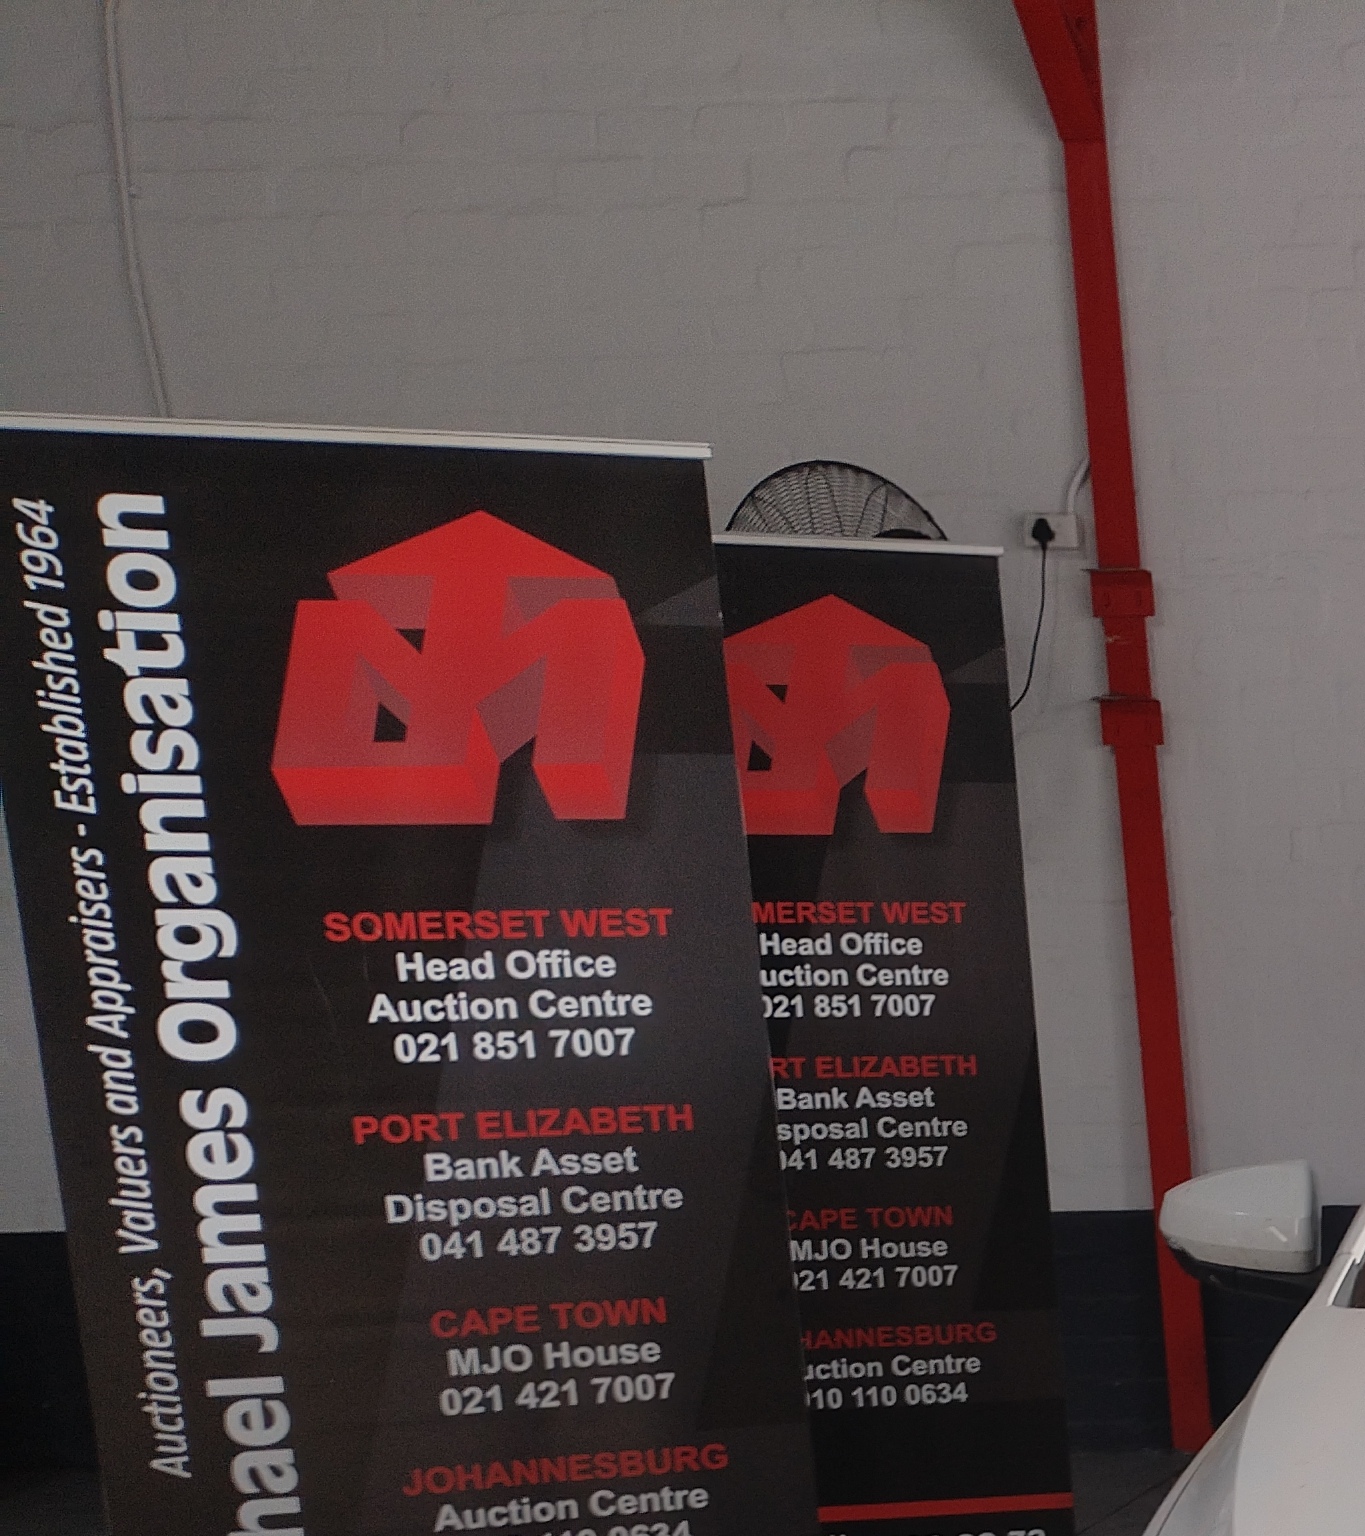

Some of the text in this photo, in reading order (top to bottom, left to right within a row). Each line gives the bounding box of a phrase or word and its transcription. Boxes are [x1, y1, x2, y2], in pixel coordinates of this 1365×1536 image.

[97, 493, 238, 1062] Organisation
[324, 908, 672, 942] SOMERSET WEST
[750, 901, 966, 924] MERSET WEST
[760, 932, 922, 955] Head Office
[396, 949, 616, 981] Head Office
[759, 963, 948, 986] uction Centre
[12, 498, 191, 1477] Auctioneers, Valuers and Appraisers Established 1964
[369, 990, 652, 1023] Auction Centre
[814, 994, 935, 1017] 851 7007
[395, 1028, 635, 1063] 021 851 7007
[815, 1054, 977, 1079] ELIZABETH
[774, 1087, 935, 1109] Bank Asset
[353, 1104, 693, 1144] PORT ELIZABETH
[776, 1116, 967, 1145] sposal Centre
[424, 1146, 639, 1181] Bank Asset
[828, 1146, 948, 1169] 487 3957
[179, 1088, 278, 1352] James
[385, 1185, 683, 1227] Disposal Centre
[865, 1205, 953, 1228] TOWN
[420, 1221, 657, 1261] 041 487 3957
[789, 1238, 948, 1261] MJO House
[839, 1265, 958, 1289] 421 7007
[430, 1297, 666, 1338] CAPE TOWN
[800, 1322, 997, 1350] HANNESBURG
[447, 1341, 660, 1376] MJO House
[891, 1354, 981, 1376] Centre
[439, 1373, 675, 1416] 021 421 7007
[851, 1382, 968, 1407] 110 0634
[402, 1443, 728, 1498] JOHANNESBURG
[434, 1486, 708, 1532] Auction Centre
